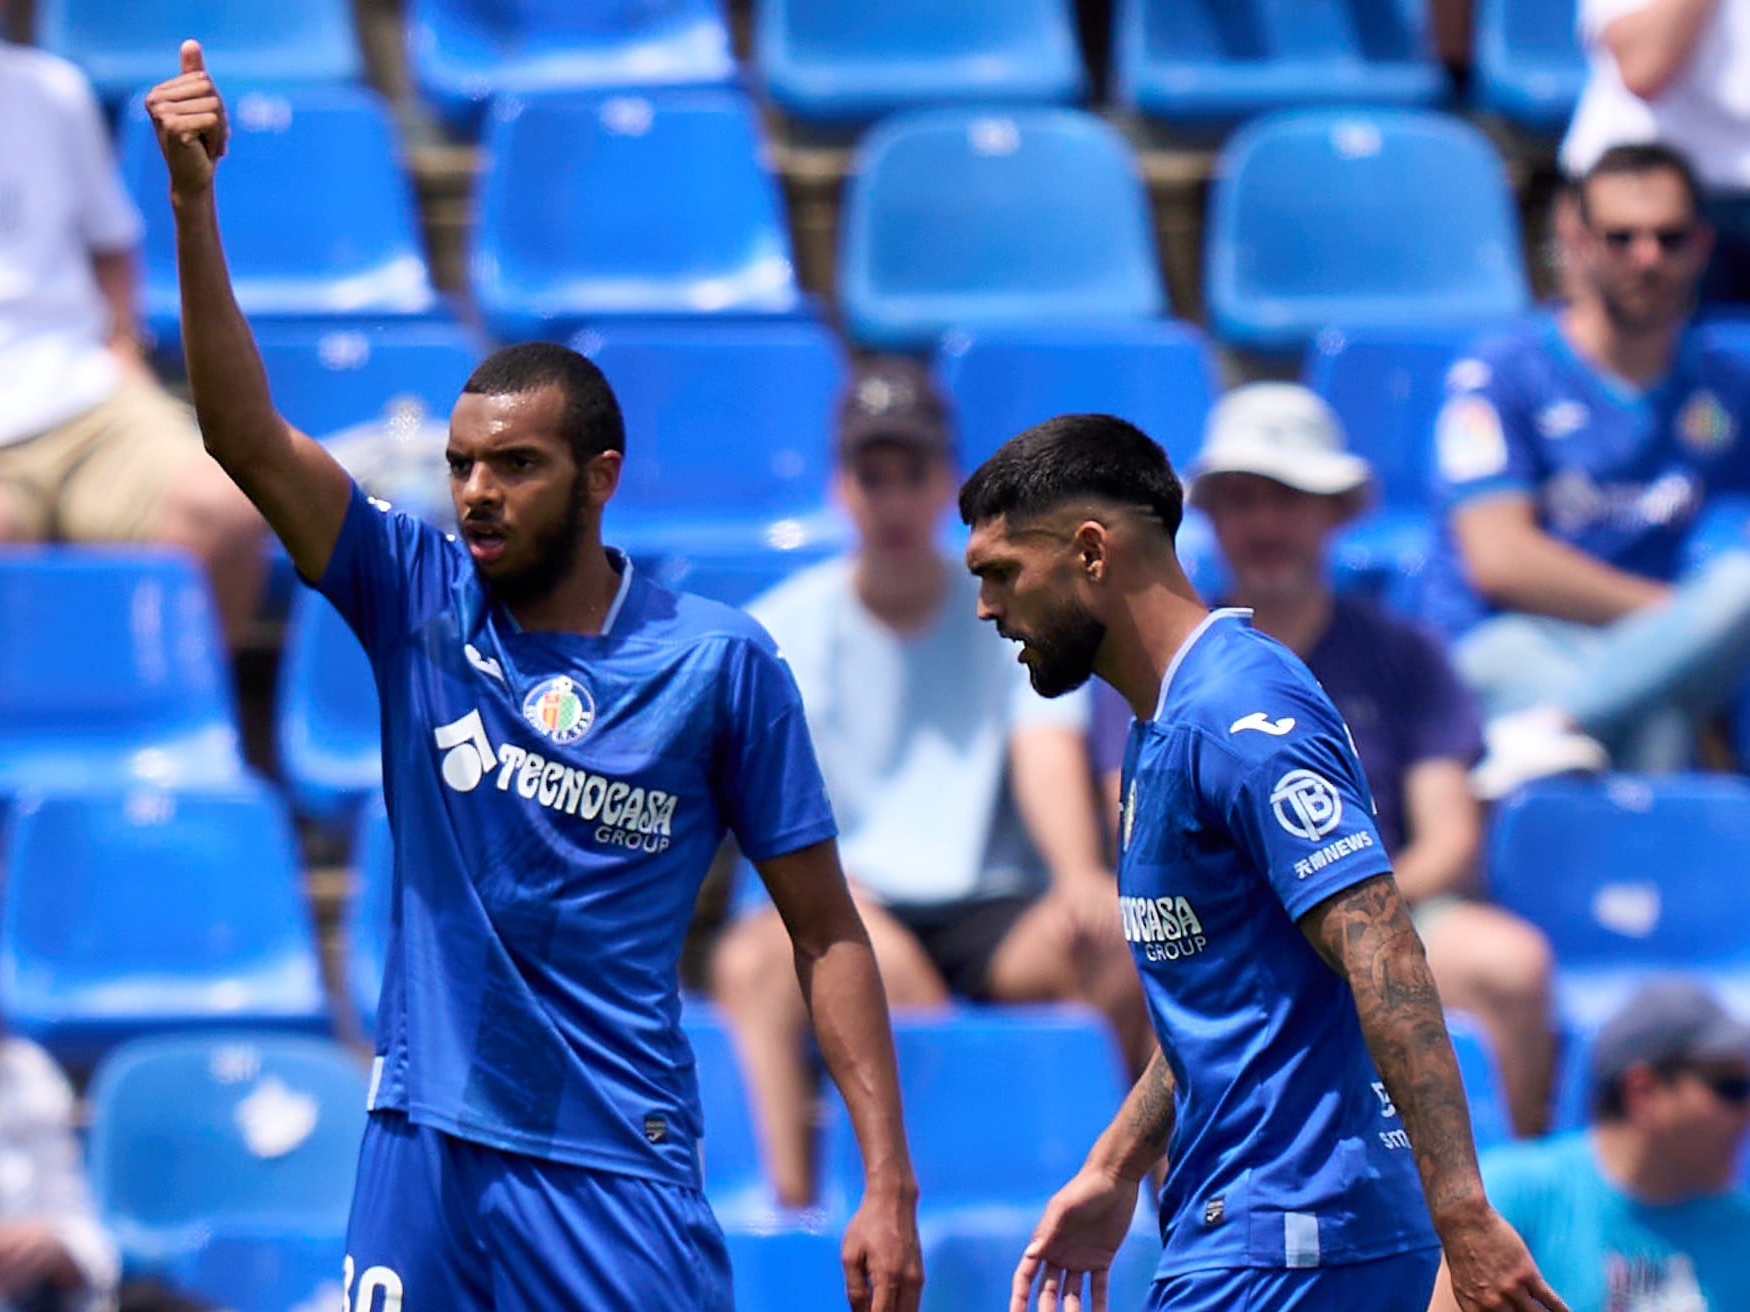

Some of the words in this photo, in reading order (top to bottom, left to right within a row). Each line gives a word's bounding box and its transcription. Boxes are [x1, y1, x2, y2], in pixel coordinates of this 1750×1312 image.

[496, 743, 678, 836] TECNOCASA
[594, 826, 670, 854] GROUP
[1145, 935, 1206, 962] GROUP
[1378, 1129, 1412, 1150] sm
